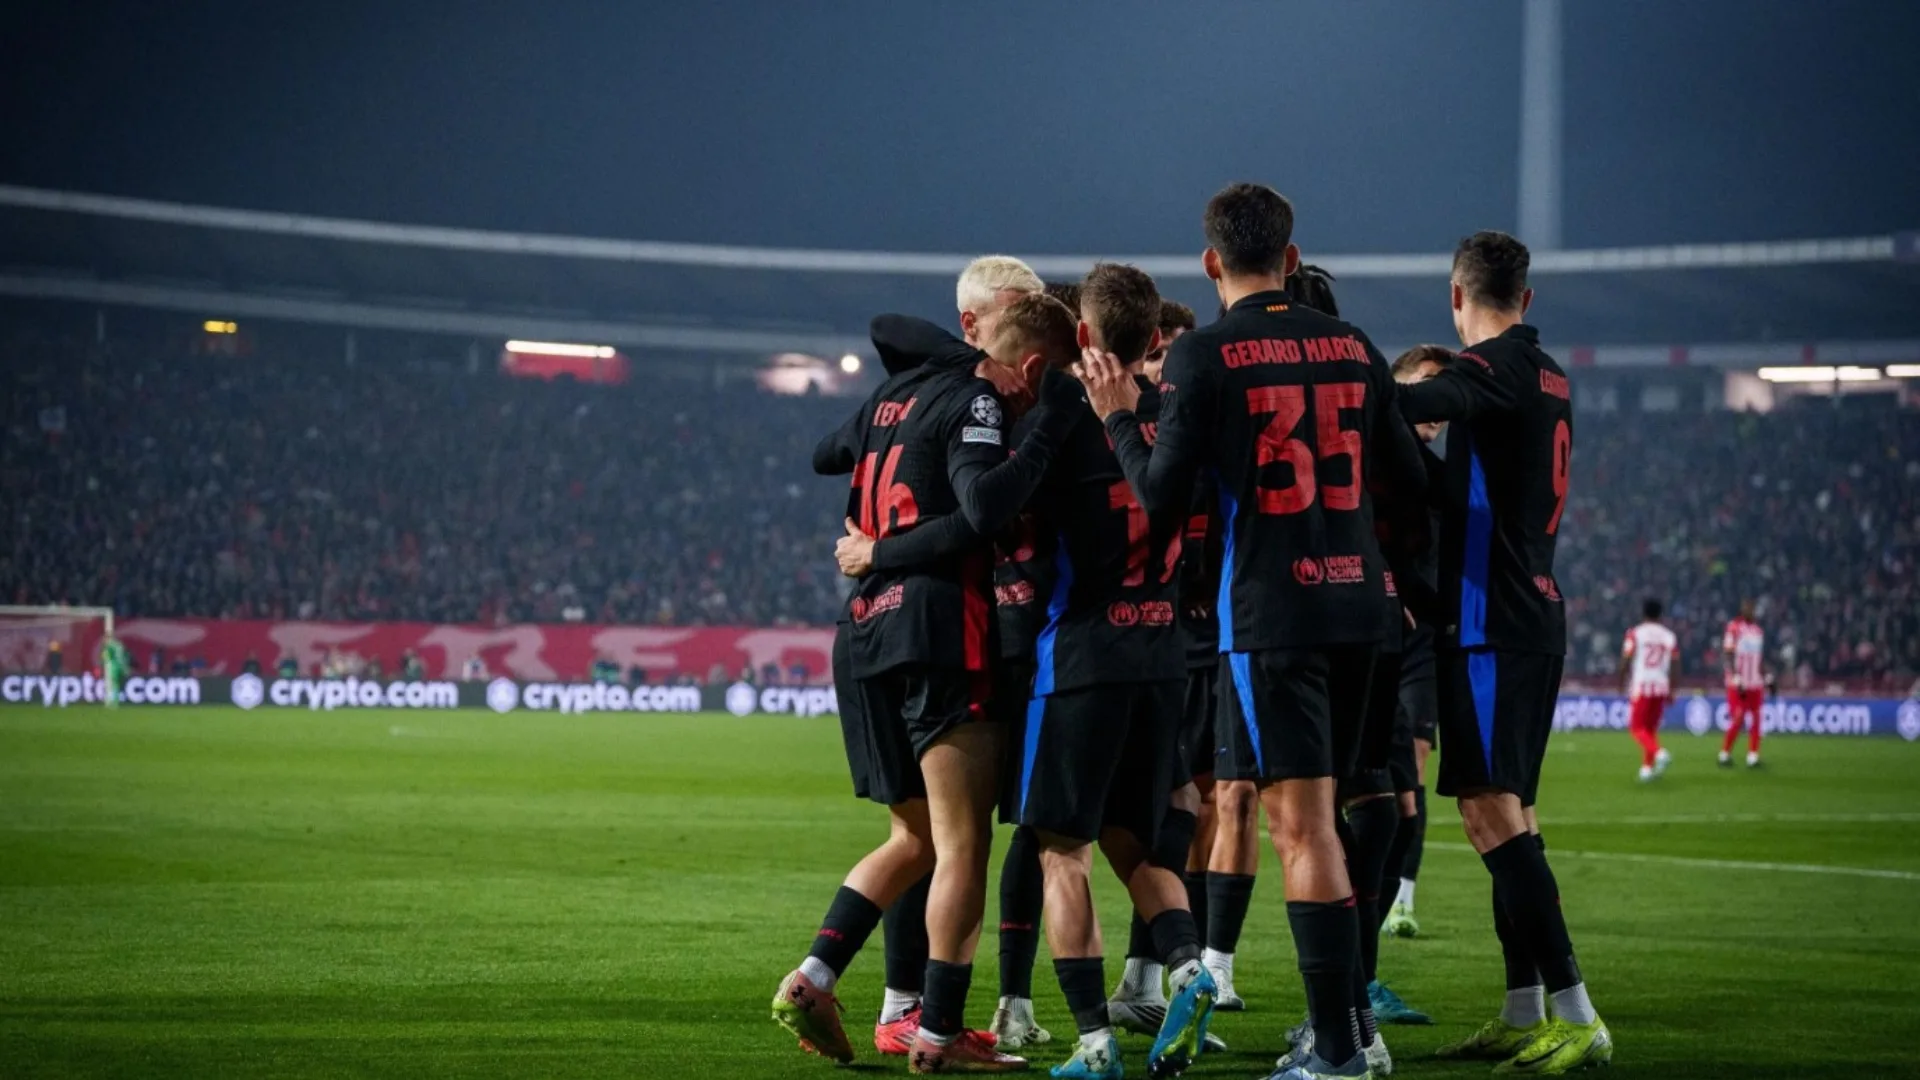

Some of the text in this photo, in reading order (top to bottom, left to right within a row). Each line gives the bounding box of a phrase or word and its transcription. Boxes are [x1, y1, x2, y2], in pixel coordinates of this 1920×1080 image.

[1220, 334, 1372, 369] GERARD MARTÍN
[1245, 382, 1367, 516] 35
[849, 443, 920, 540] 16
[1544, 418, 1573, 537] 9
[269, 676, 460, 712] crypto.com
[523, 680, 702, 714] crypto.com
[1715, 697, 1872, 736] cpto.com
